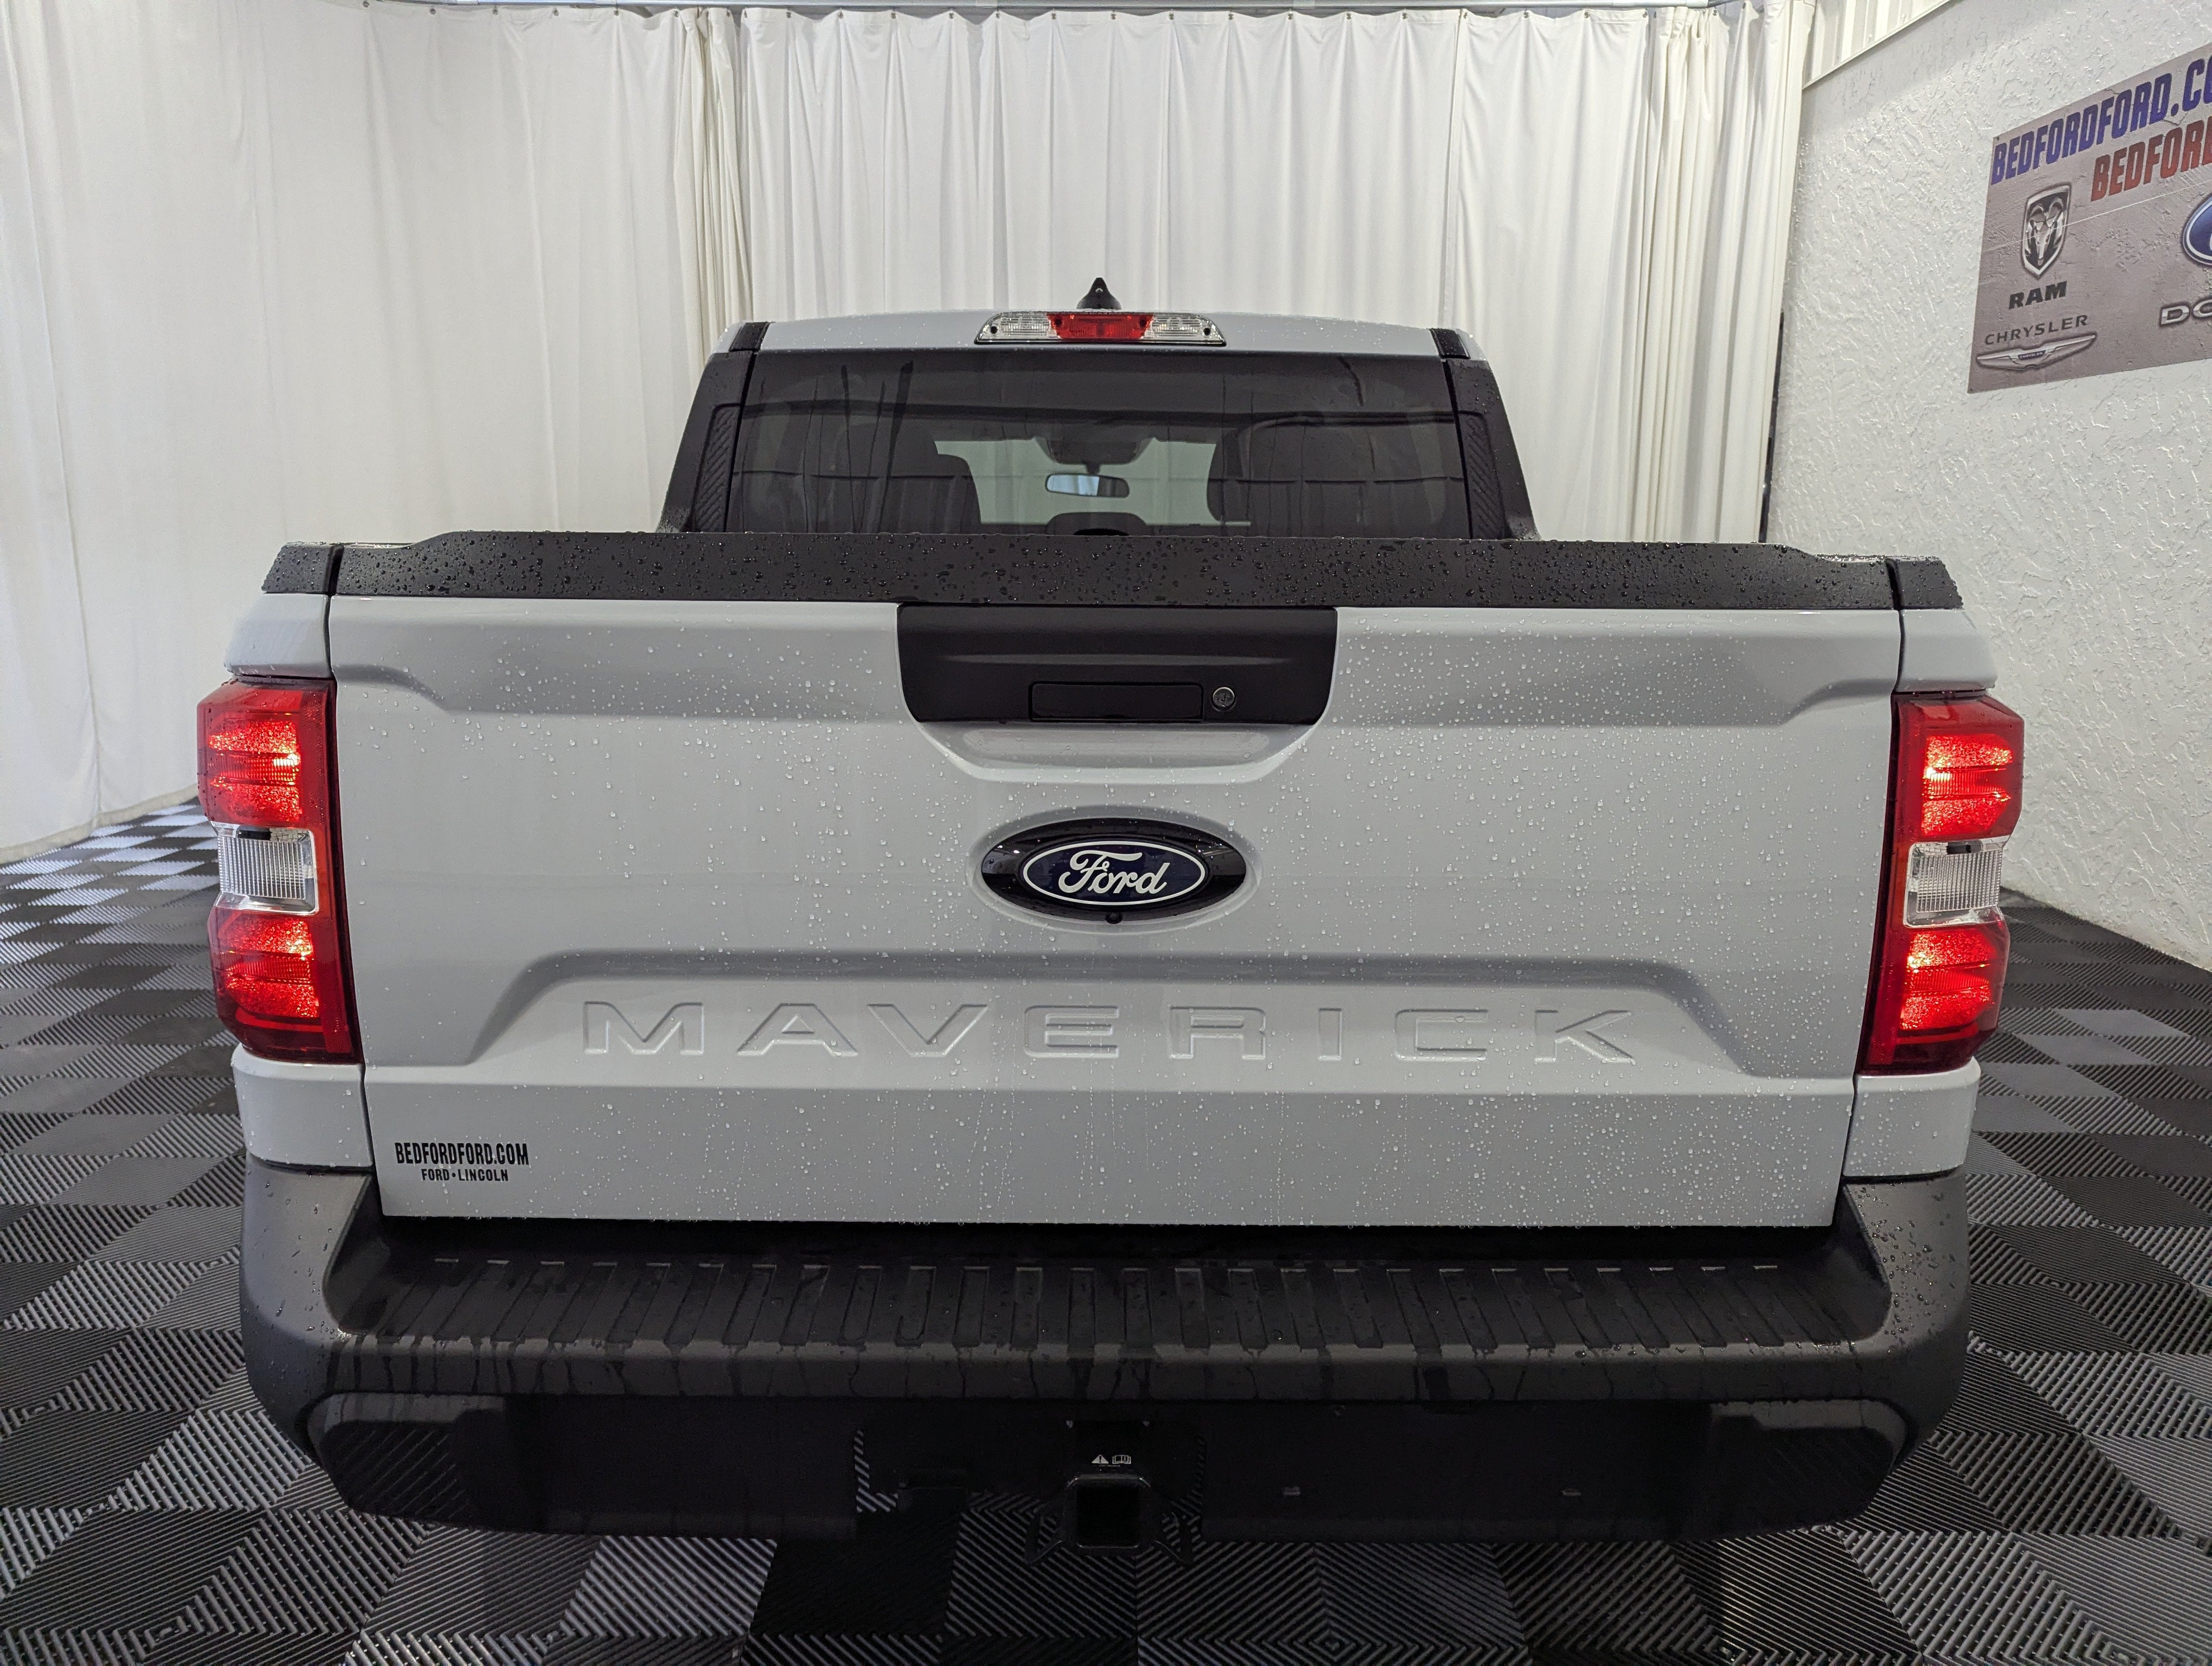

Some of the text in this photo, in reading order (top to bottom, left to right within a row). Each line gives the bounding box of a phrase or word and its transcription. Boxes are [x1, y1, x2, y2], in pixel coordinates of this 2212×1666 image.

[2009, 281, 2067, 309] RAM
[1985, 315, 2087, 345] CHRYSLER
[1058, 850, 1170, 894] Ford
[583, 1001, 1635, 1064] MAVERICK
[395, 1142, 529, 1165] BEDFORDFORD.COM
